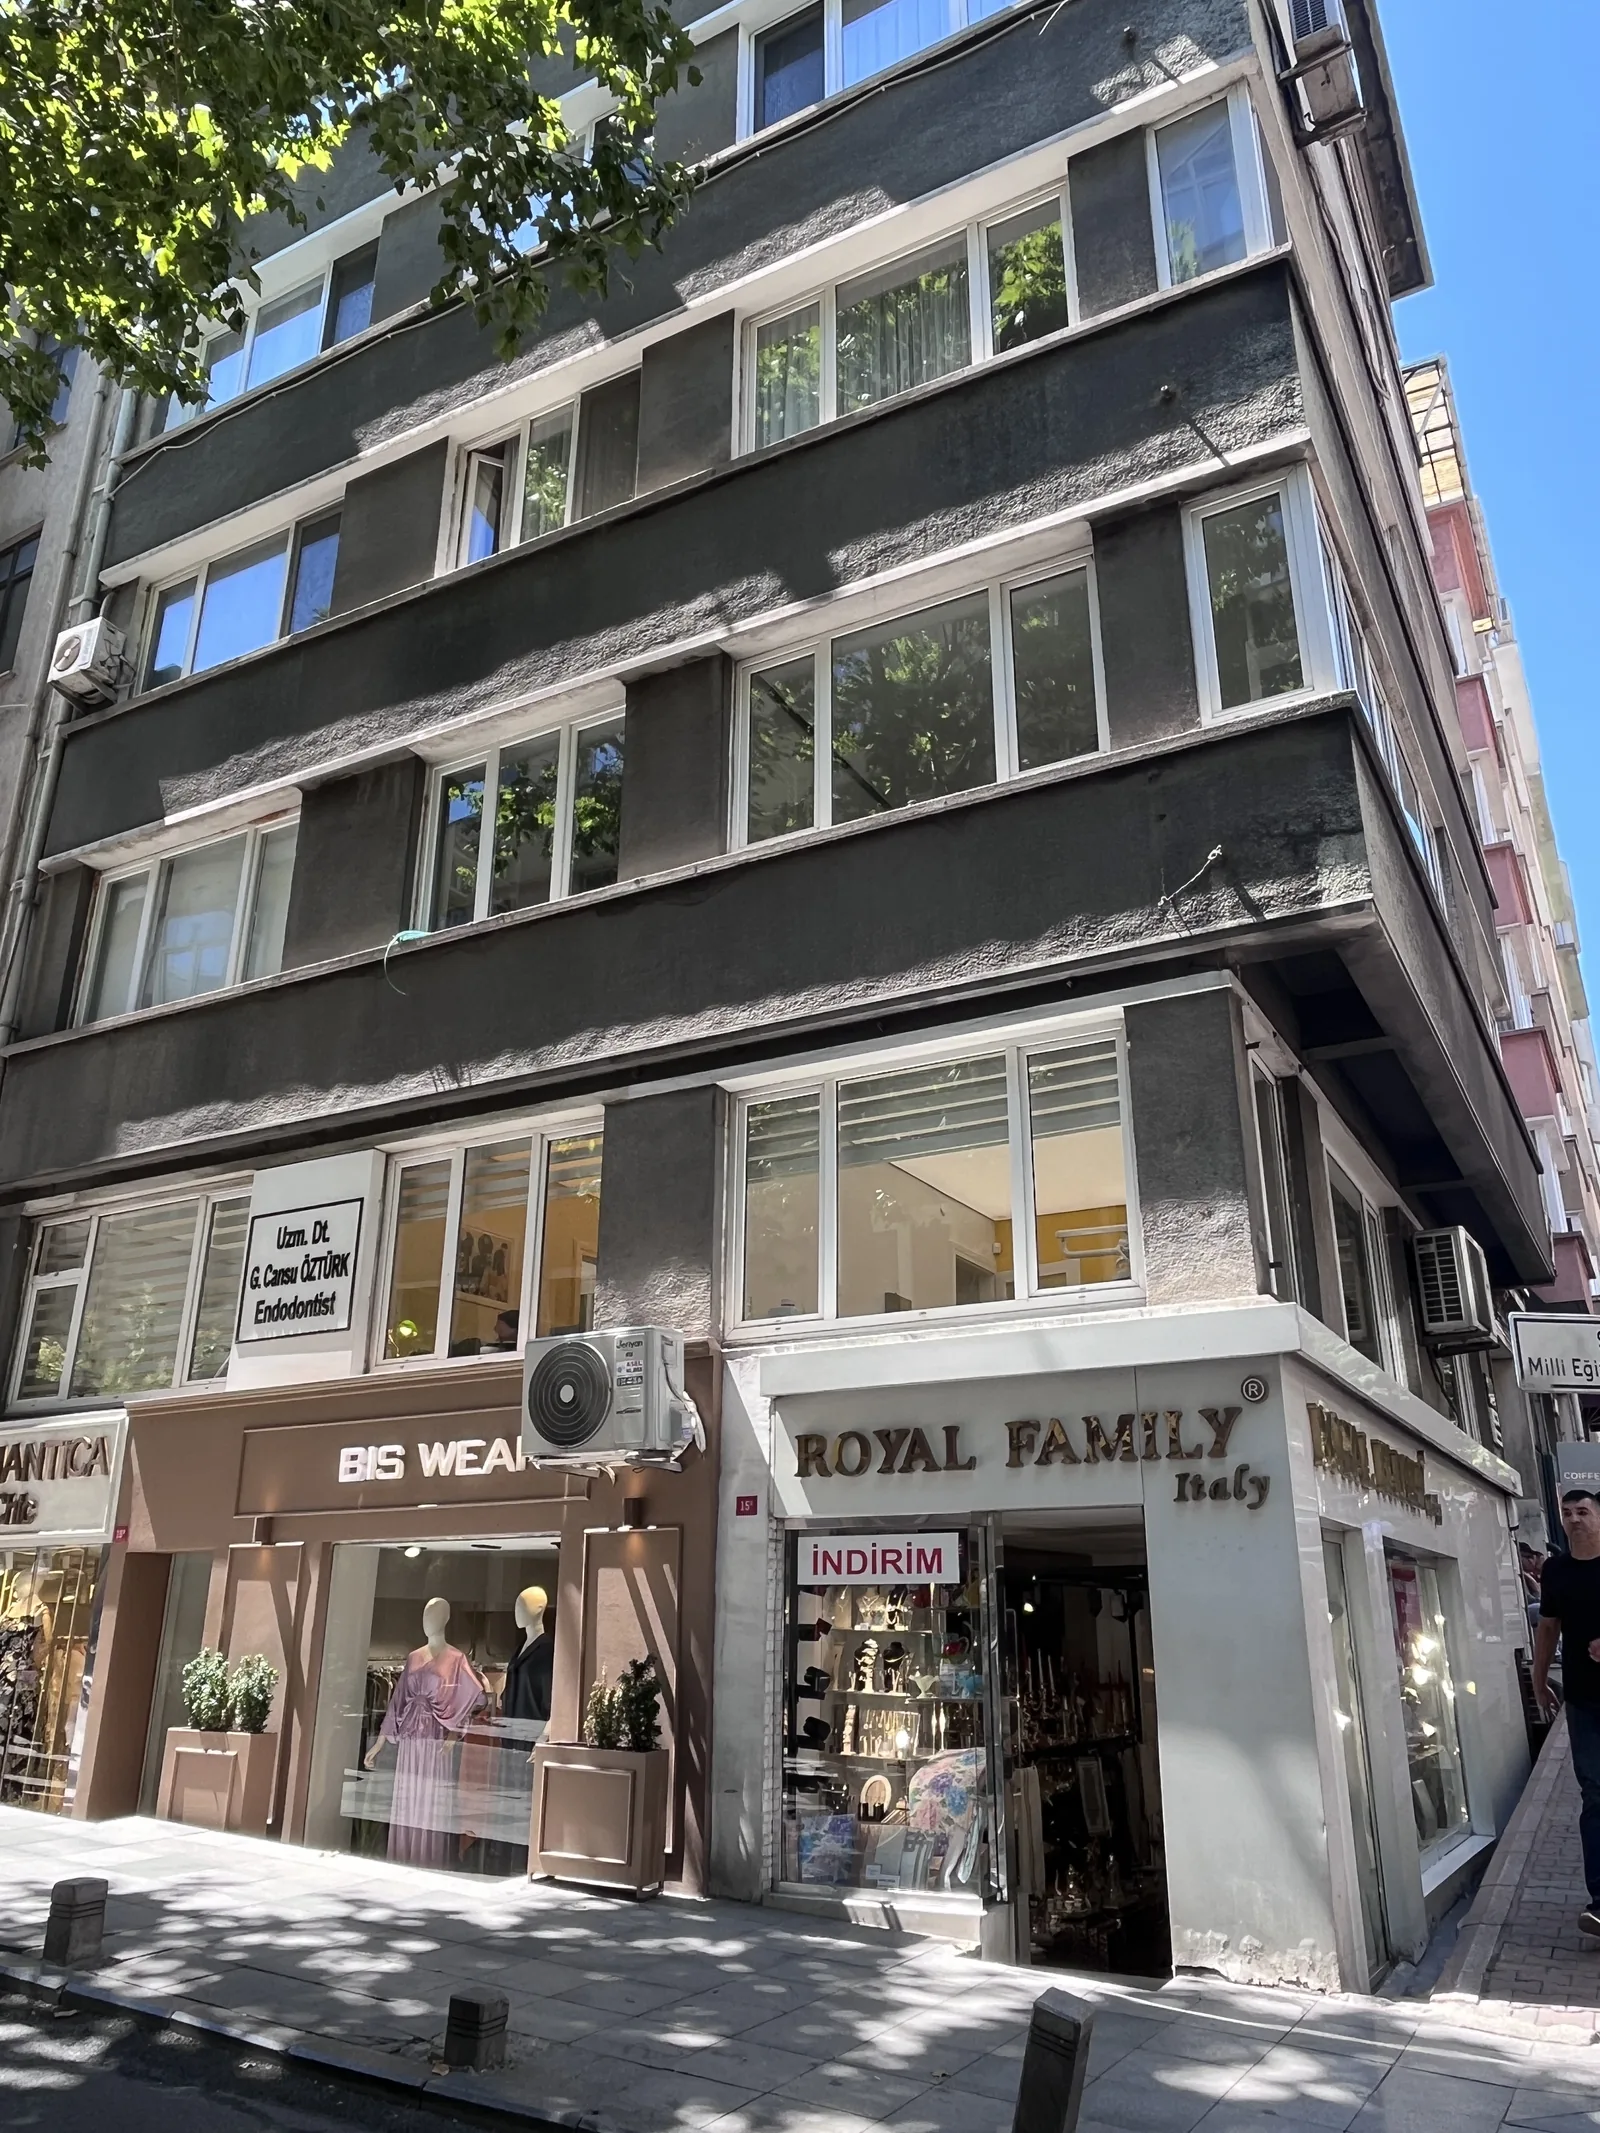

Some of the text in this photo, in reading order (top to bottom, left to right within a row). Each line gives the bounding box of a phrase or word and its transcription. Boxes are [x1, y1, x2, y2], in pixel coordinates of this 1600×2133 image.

[276, 1226, 308, 1250] Uzm.
[250, 1250, 351, 1290] G. Cansu ÖZTÜRK
[254, 1290, 336, 1325] Endodontist
[1527, 1357, 1600, 1382] Milli Eği
[0, 1436, 110, 1484] ANTICA
[793, 1425, 977, 1478] ROYAL
[1004, 1406, 1243, 1468] FAMILY
[338, 1444, 406, 1483] BIS
[1172, 1463, 1271, 1511] Italy
[812, 1541, 943, 1576] İNDİRİM
